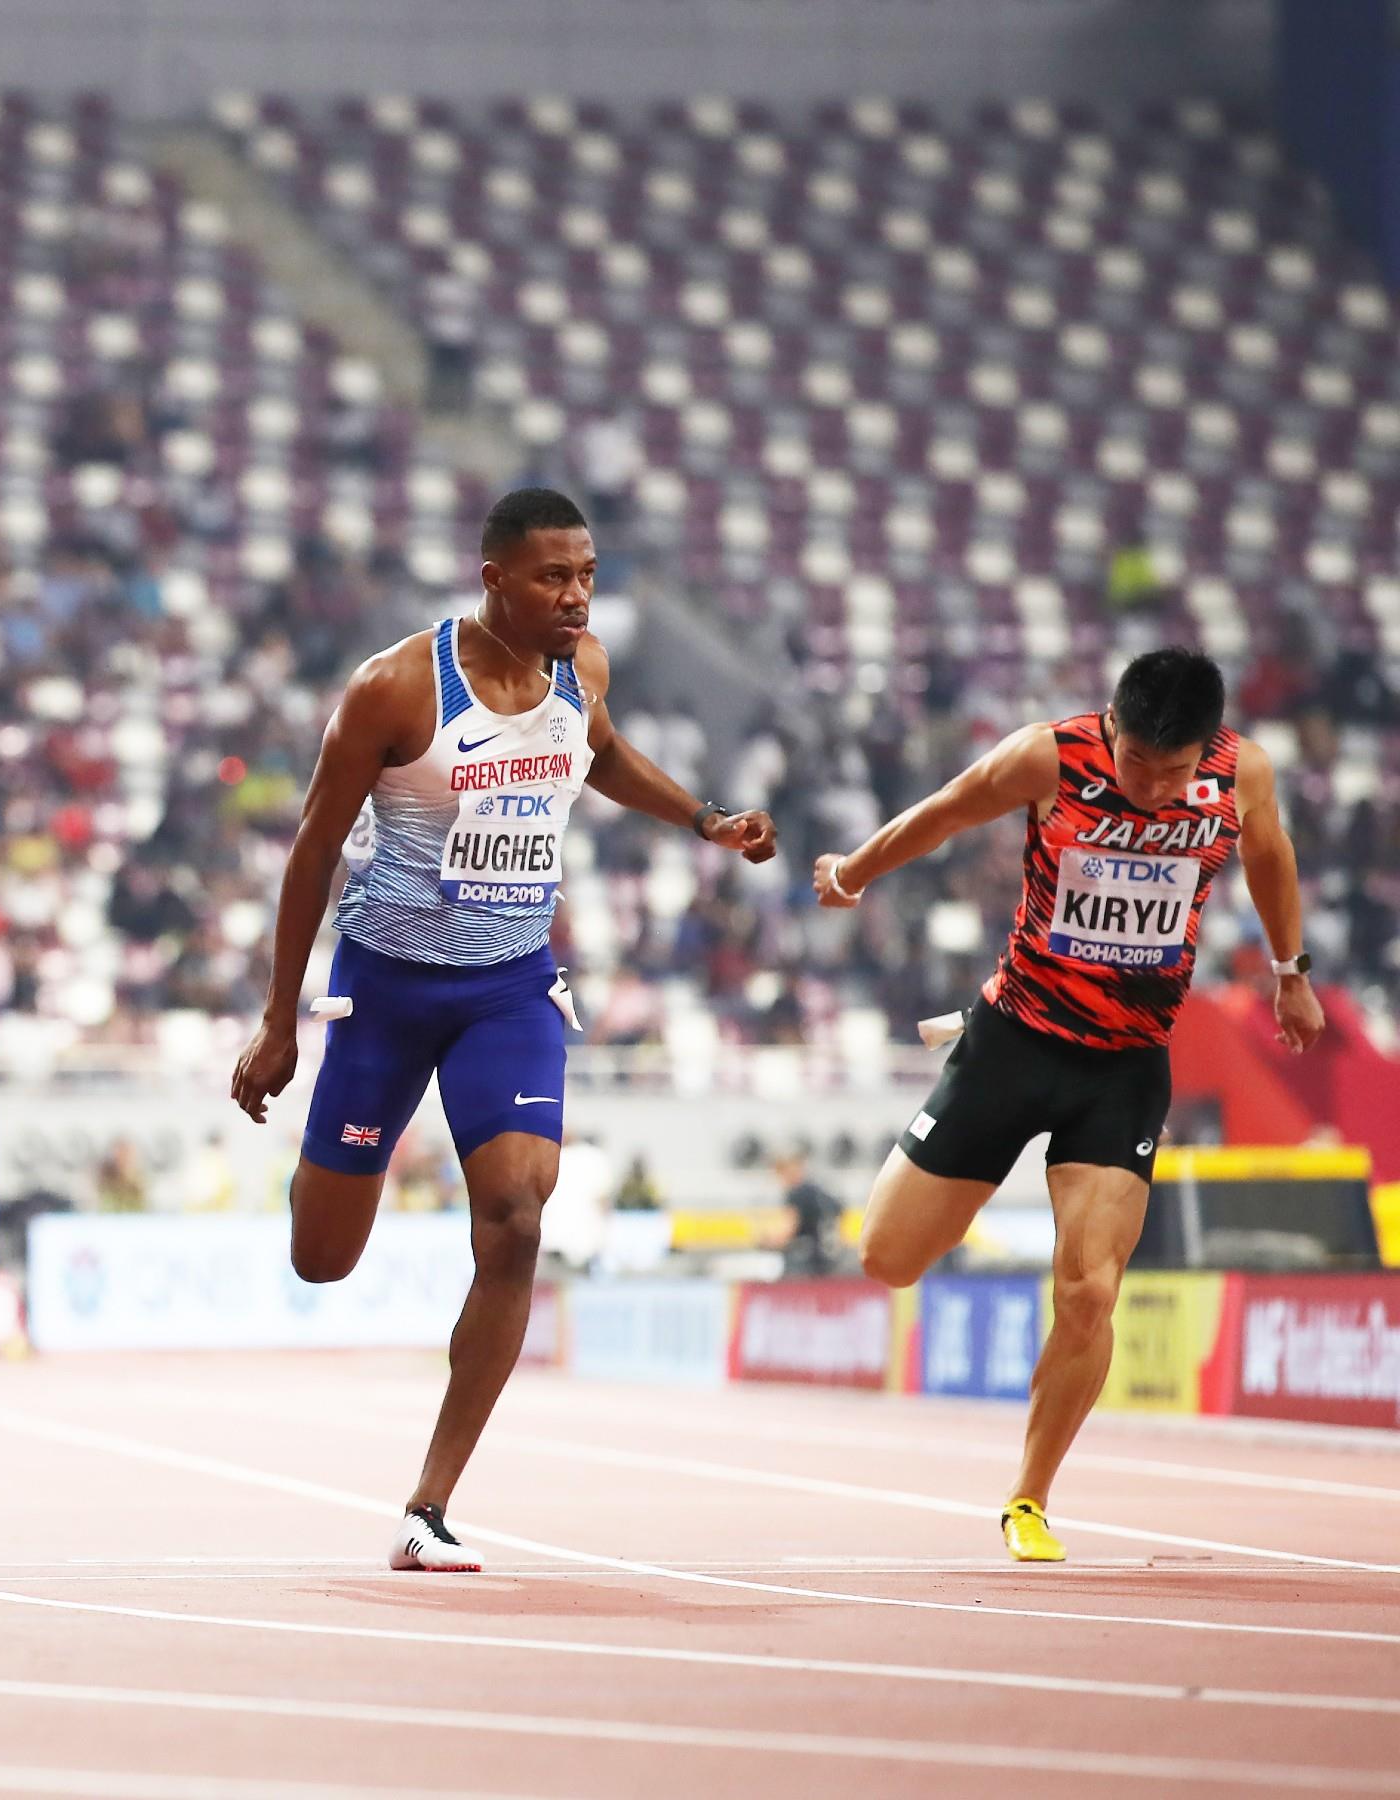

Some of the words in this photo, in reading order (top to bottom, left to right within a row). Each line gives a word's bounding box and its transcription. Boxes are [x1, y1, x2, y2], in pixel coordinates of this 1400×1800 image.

[450, 760, 509, 792] GREAT
[509, 752, 573, 782] BRITAIN
[496, 794, 555, 817] TDK
[1076, 815, 1223, 852] JAPAN
[449, 832, 556, 872] HUGHES
[1105, 857, 1179, 885] TDK
[457, 882, 545, 904] DOHA2019
[1062, 889, 1182, 935] KIRYU
[1069, 939, 1164, 966] DOHA2019
